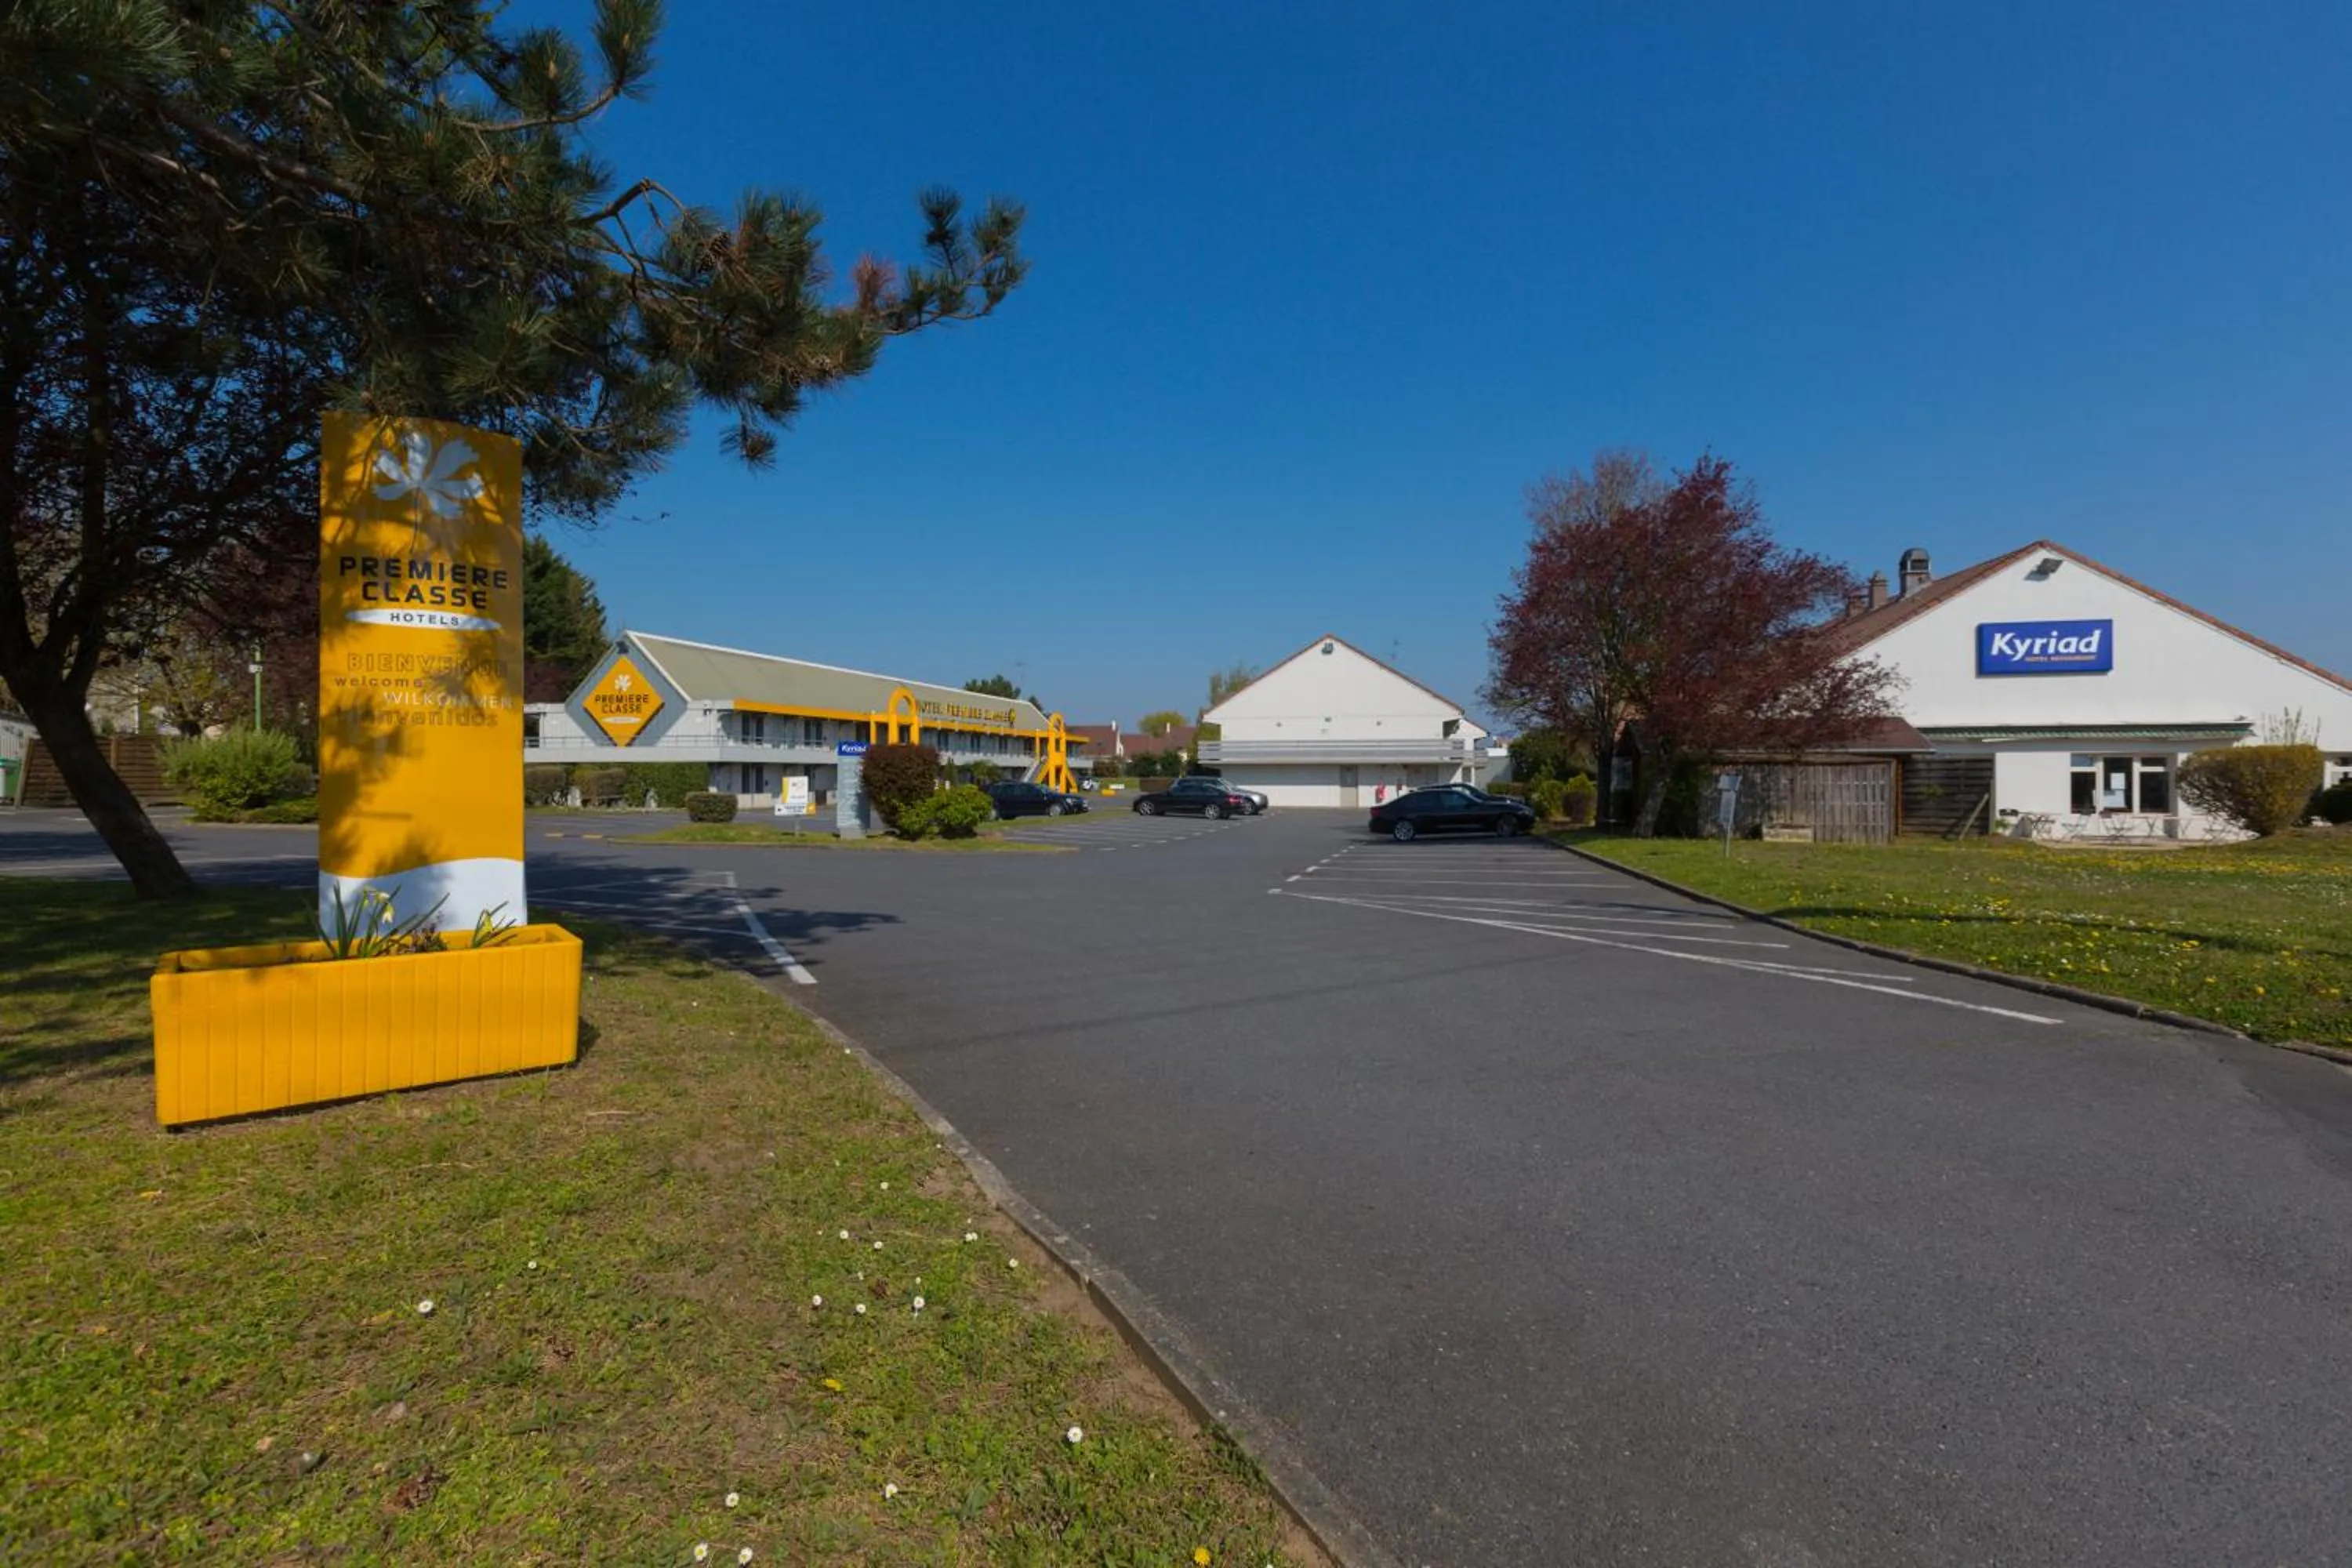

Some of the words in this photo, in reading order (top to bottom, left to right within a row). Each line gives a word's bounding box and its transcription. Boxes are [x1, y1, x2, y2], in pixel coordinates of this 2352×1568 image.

[339, 556, 508, 589] PREMIERE
[362, 582, 488, 609] CLASSE
[390, 612, 459, 626] HOTELS
[1991, 630, 2102, 662] Kyriad
[335, 675, 423, 688] welcome
[595, 694, 649, 703] PREMIERE
[601, 703, 642, 714] CLASSE
